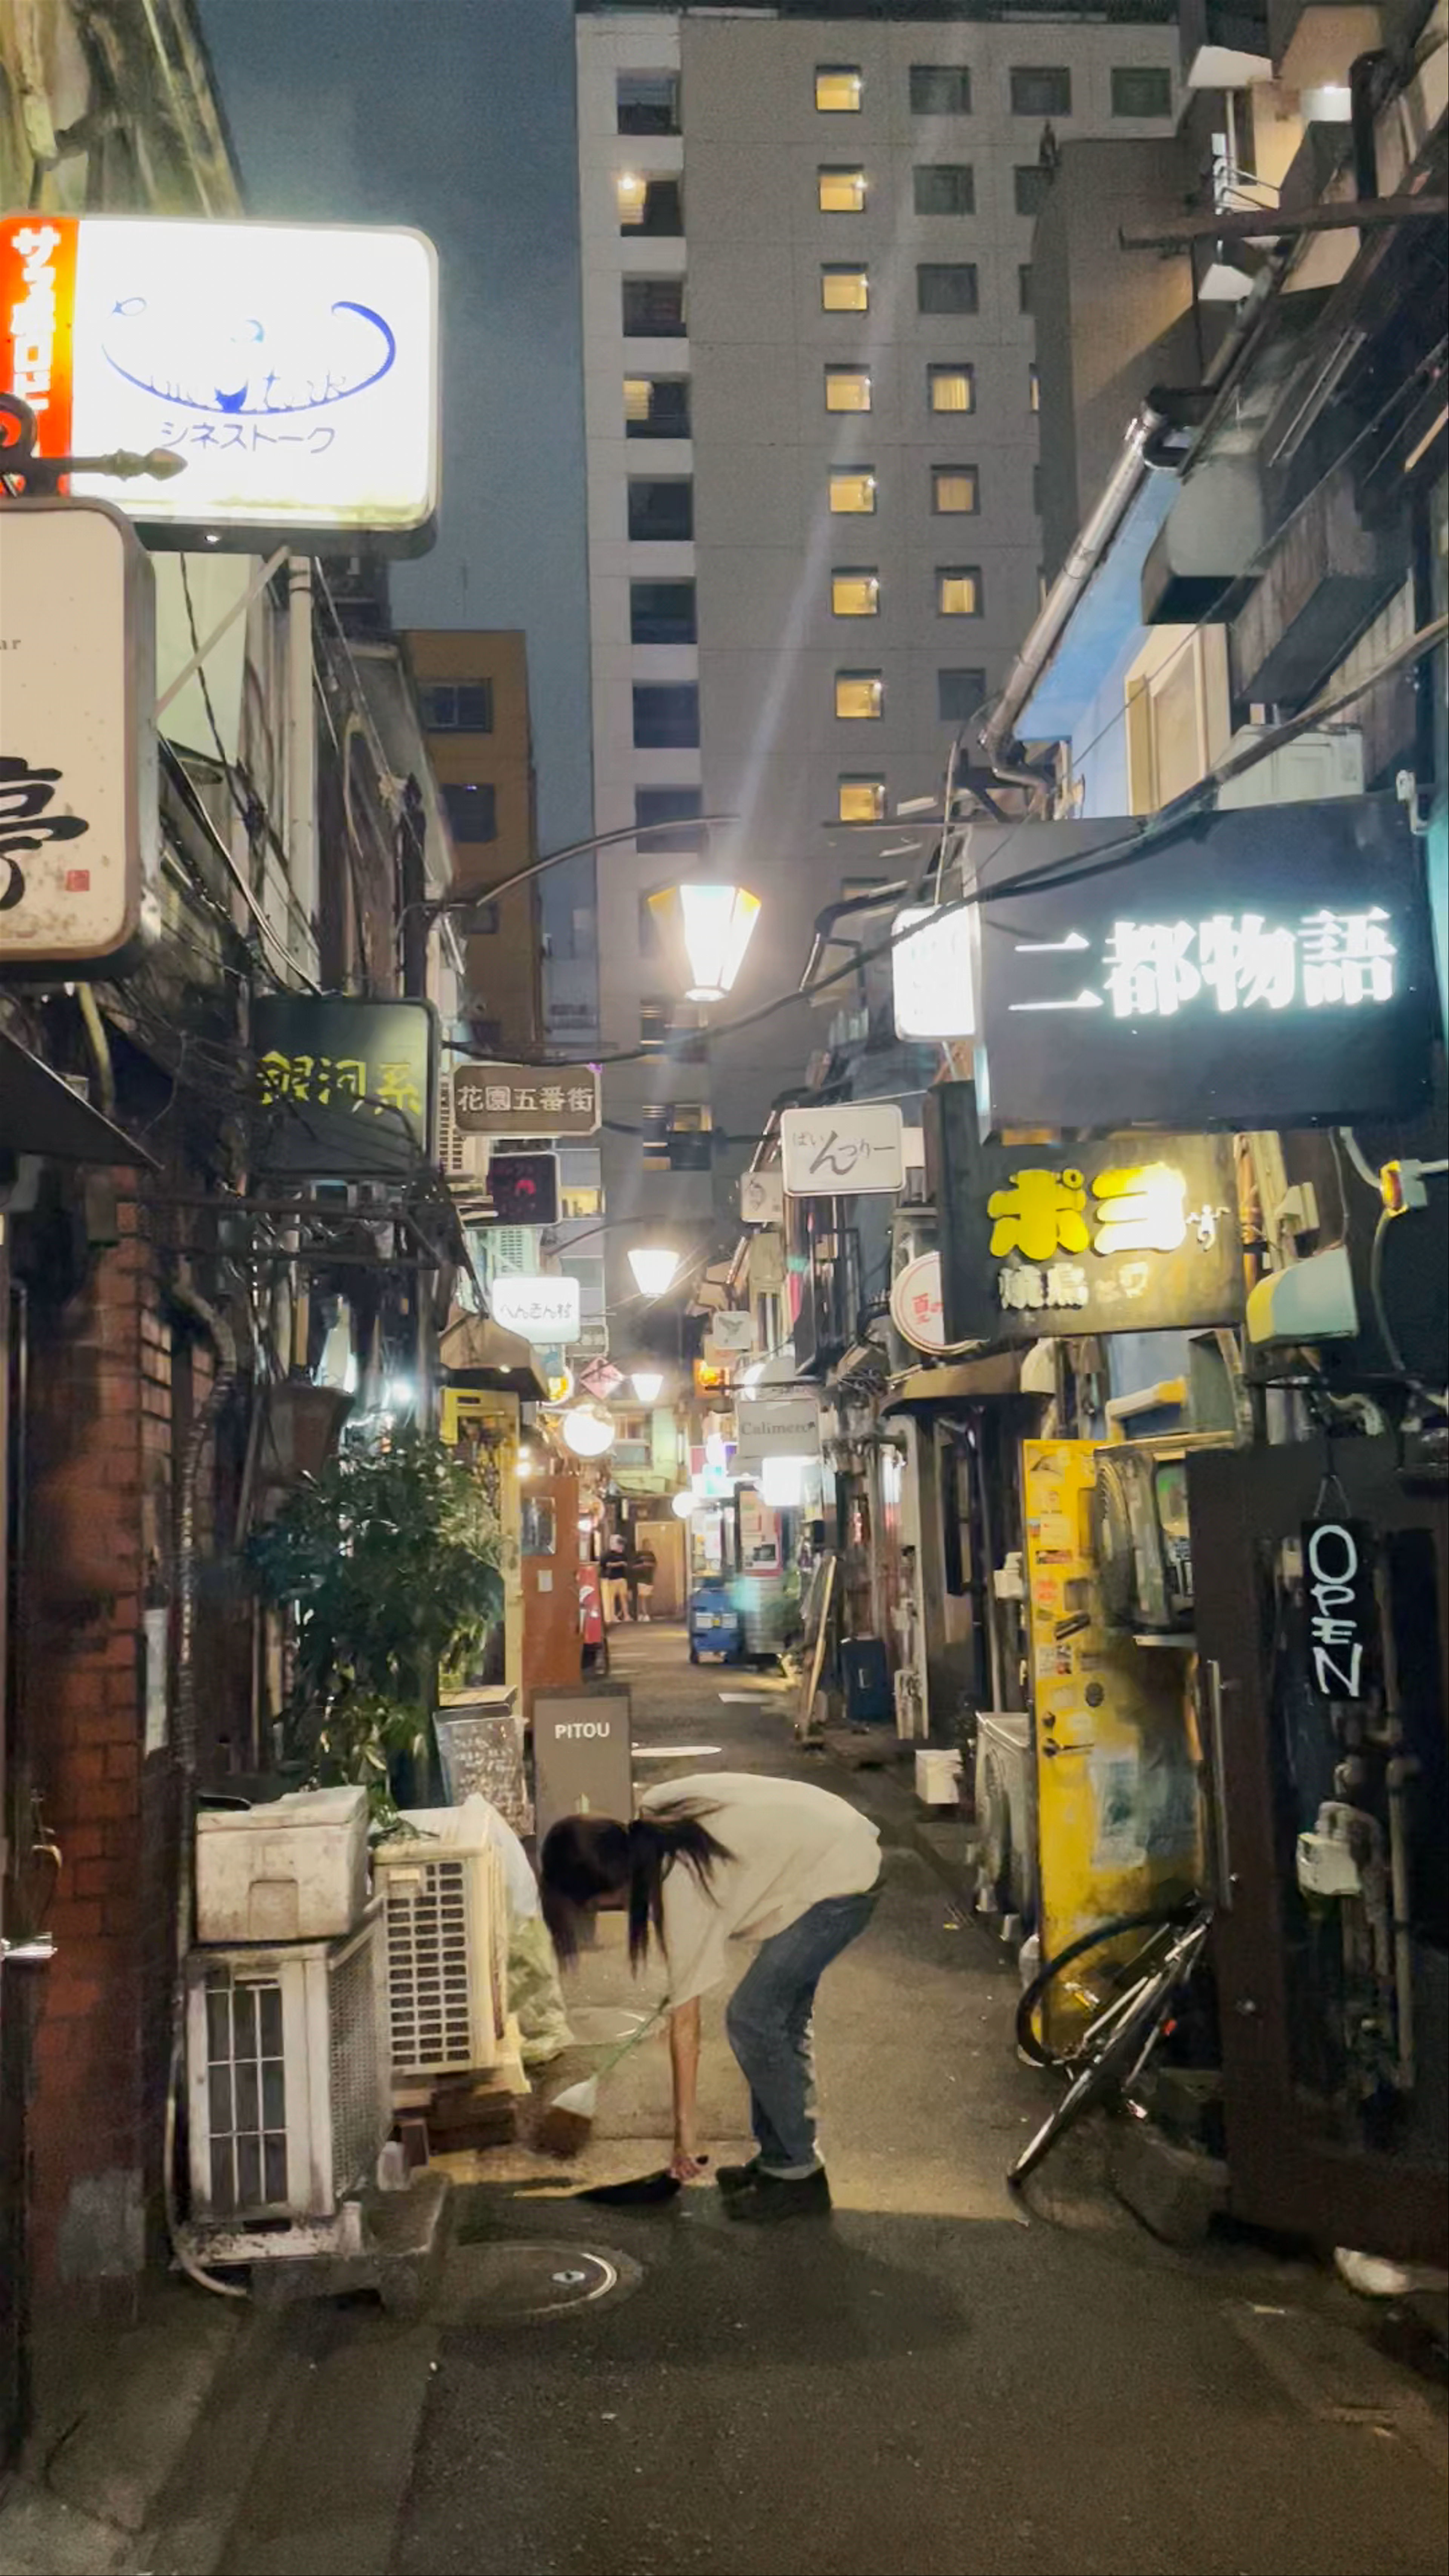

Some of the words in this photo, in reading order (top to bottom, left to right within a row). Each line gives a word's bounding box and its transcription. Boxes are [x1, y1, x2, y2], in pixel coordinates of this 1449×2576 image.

[161, 421, 335, 454] シネストーク
[1008, 906, 1397, 1017] 二都物語
[257, 1051, 422, 1115] 銀河系
[457, 1085, 594, 1112] 花園五番街
[1308, 1525, 1363, 1697] OPEN
[555, 1722, 610, 1739] PITOU
